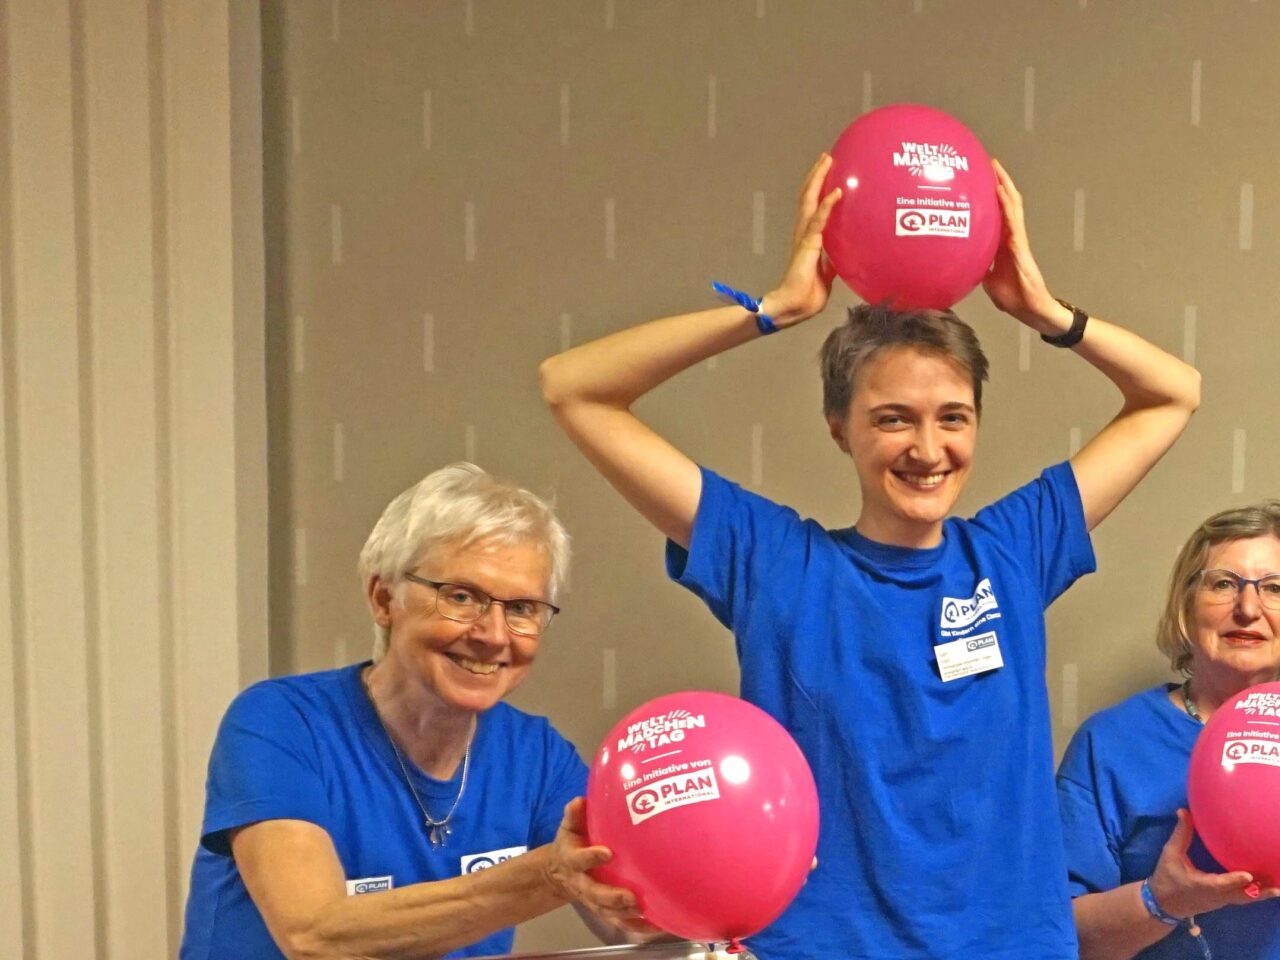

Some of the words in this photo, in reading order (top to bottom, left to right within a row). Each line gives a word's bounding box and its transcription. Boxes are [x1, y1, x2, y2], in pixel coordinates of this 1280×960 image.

[901, 142, 938, 155] WELT
[896, 197, 915, 205] Eine
[916, 198, 954, 208] Initiative
[955, 201, 970, 209] von
[929, 214, 967, 228] PLAN
[961, 586, 994, 616] PLAN
[617, 715, 706, 752] MÄDCHEN
[627, 715, 667, 735] WELT
[646, 729, 685, 748] TAG
[623, 777, 643, 791] Eine
[643, 763, 688, 781] Initiative
[690, 759, 712, 768] von
[660, 776, 713, 799] PLAN
[368, 882, 388, 890] PLAN
